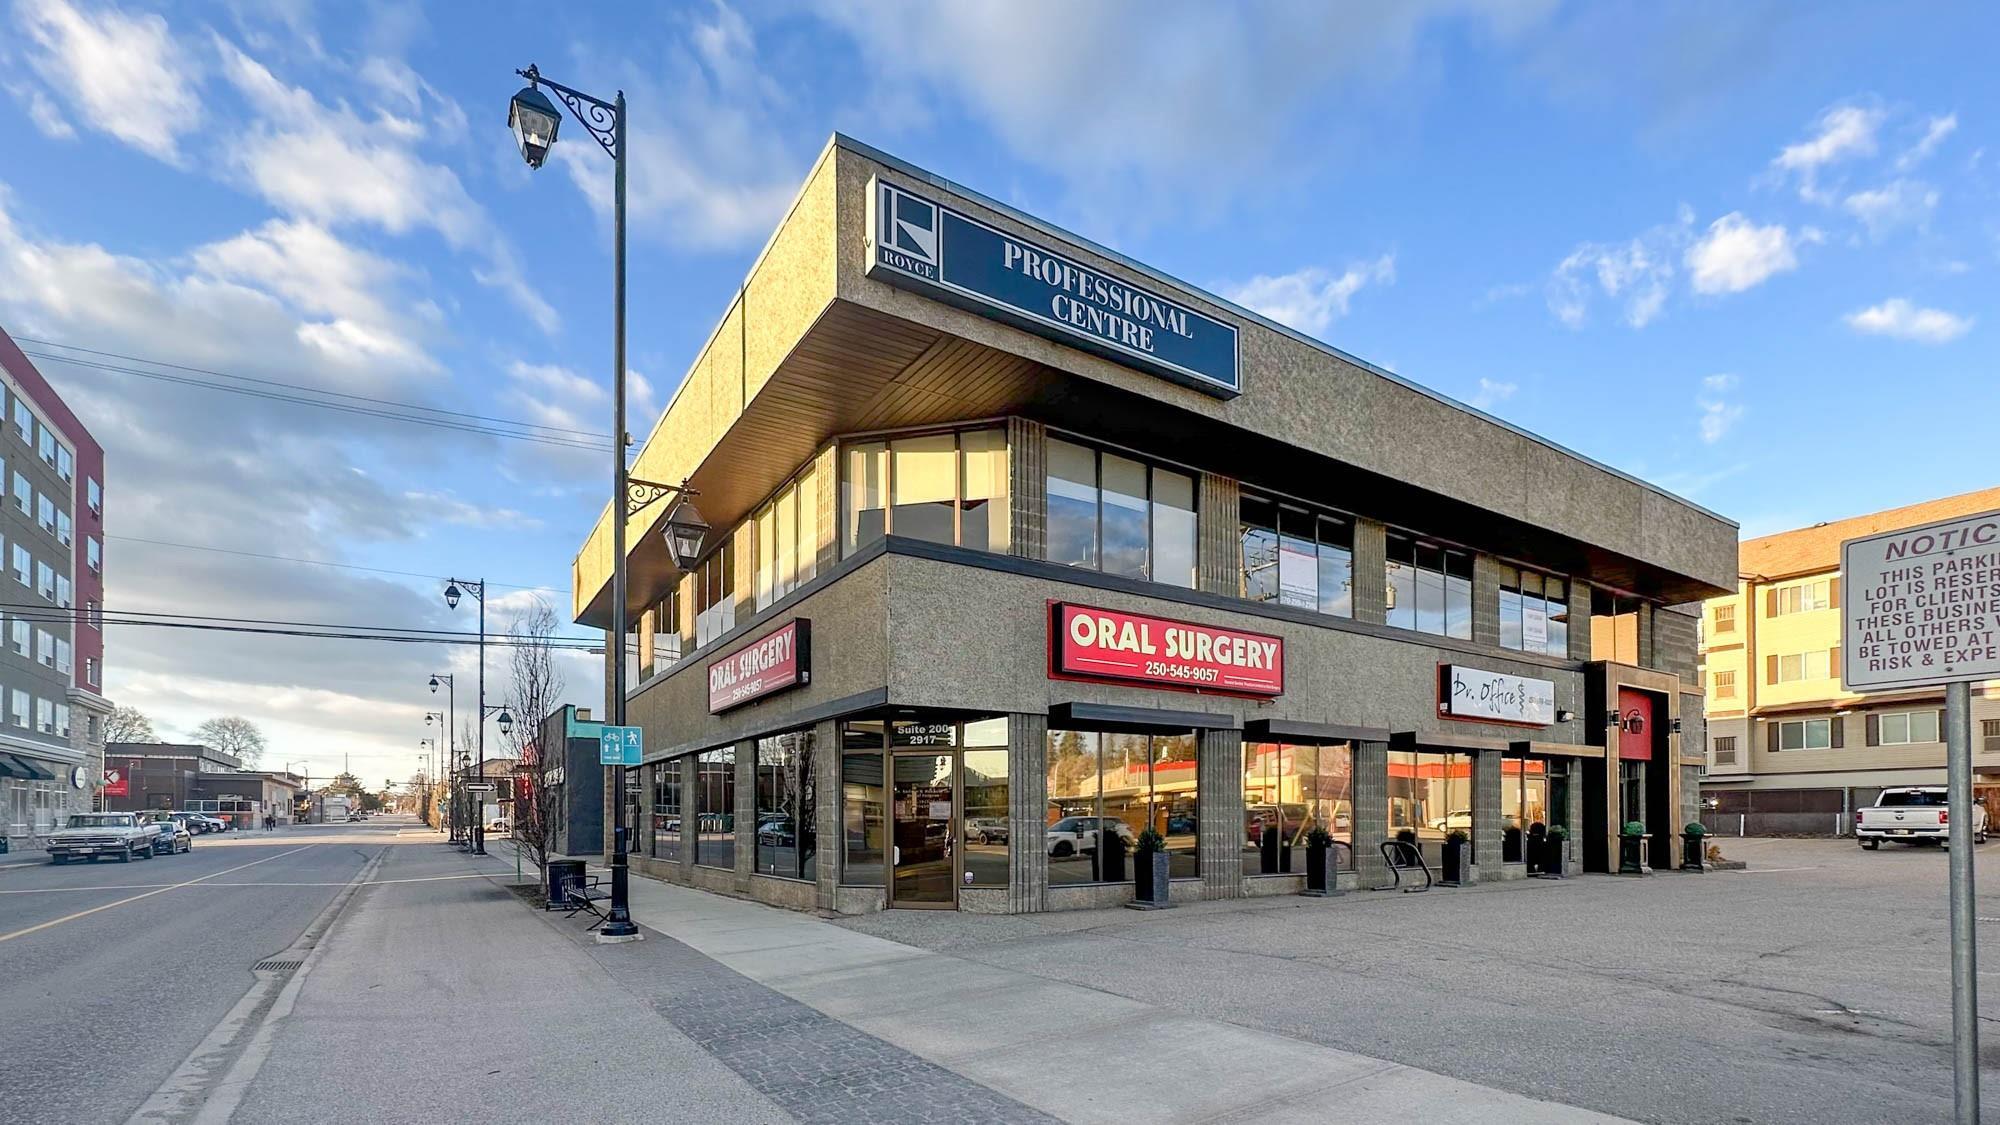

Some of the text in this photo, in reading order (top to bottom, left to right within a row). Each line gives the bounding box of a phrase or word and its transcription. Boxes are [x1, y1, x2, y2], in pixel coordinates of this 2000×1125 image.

[883, 250, 934, 279] ROYCE
[1003, 241, 1193, 339] PROFESSIONAL
[1051, 294, 1154, 353] CENTRE
[1880, 552, 2000, 585] THIS PARKI
[1865, 585, 1899, 601] LOT
[1907, 580, 1925, 595] IS
[1871, 583, 2000, 615] FOR CLIENTS
[1856, 611, 1915, 631] THESE
[1924, 600, 2000, 622] BUSINE
[1863, 629, 1896, 644] ALL
[1905, 616, 1985, 639] OTHERS
[1070, 613, 1278, 671] ORAL SURGERY
[1859, 631, 1994, 659] BE TOWED AT
[711, 630, 793, 693] ORAL SURGERY
[1869, 655, 1913, 672] RISK
[1921, 653, 1934, 666] &
[1453, 673, 1515, 714] Dr. Office
[897, 724, 949, 735] Suite 200
[909, 735, 937, 745] 2917
